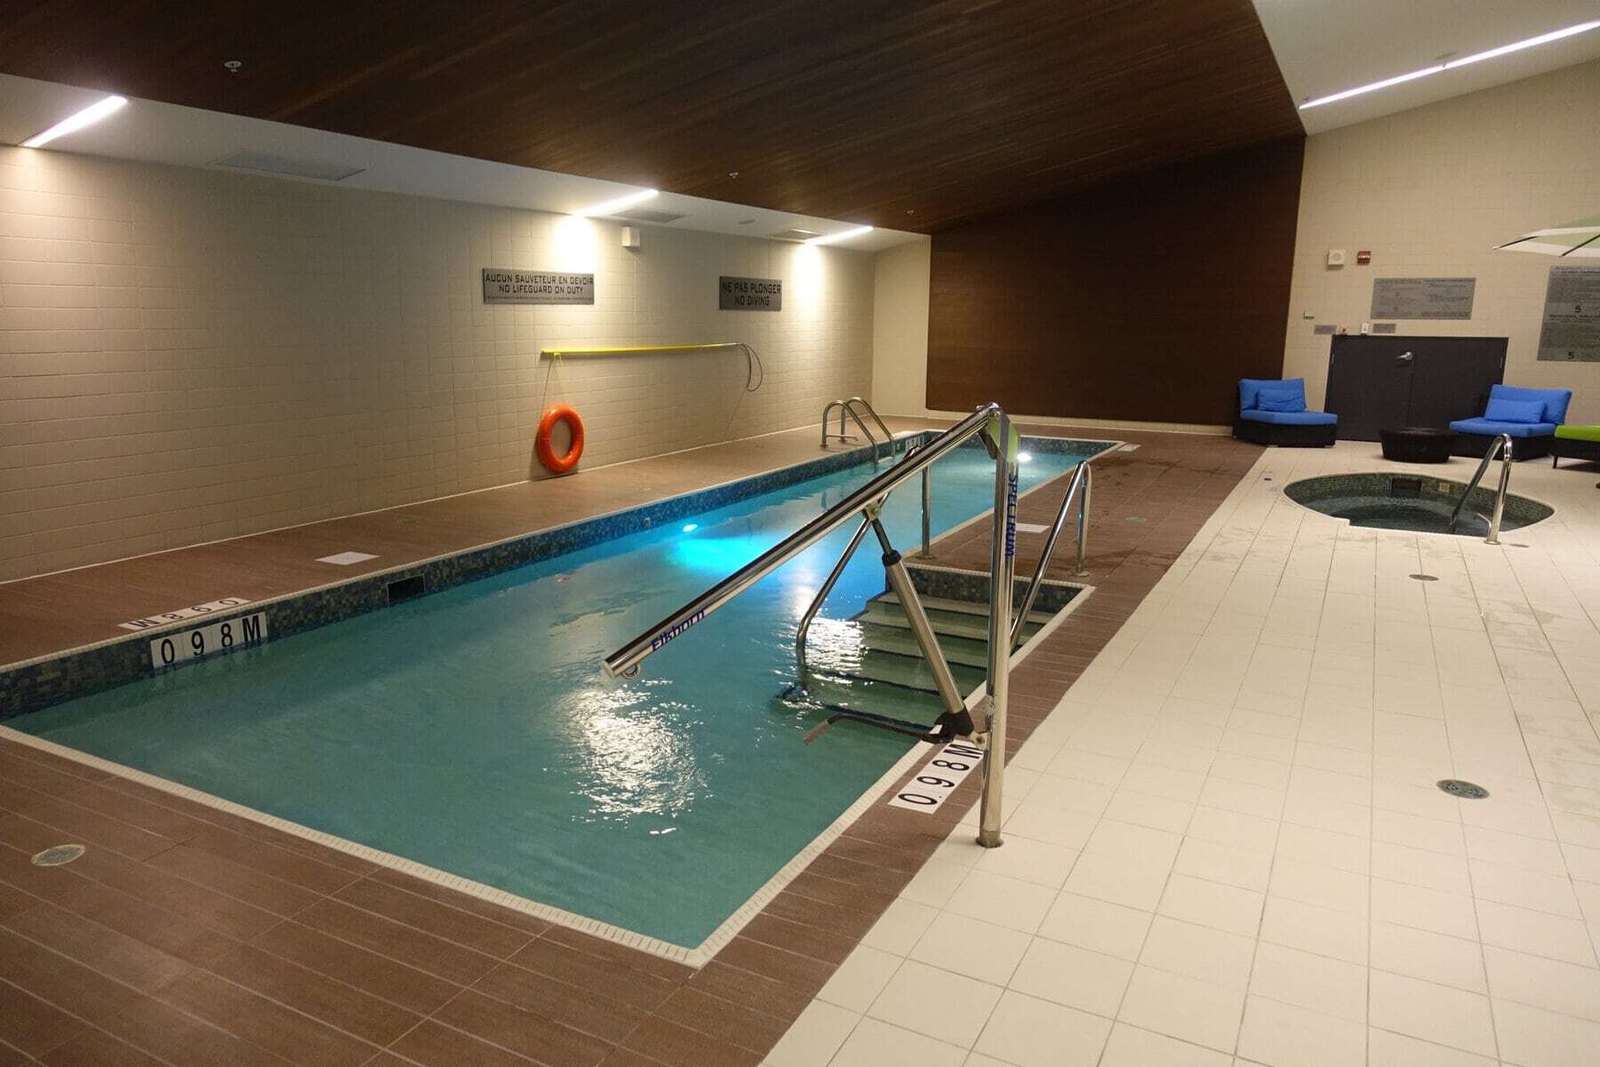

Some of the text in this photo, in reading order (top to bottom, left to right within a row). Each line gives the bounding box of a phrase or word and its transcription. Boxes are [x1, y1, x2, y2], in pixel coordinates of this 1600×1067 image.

[485, 273, 594, 285] AUCUN SAUVETEUR EN DEVOIR
[498, 284, 584, 295] NO LIFEGUARD ON DUTY
[722, 281, 781, 294] NE PAS PLONGER
[734, 295, 770, 306] NO DIVING
